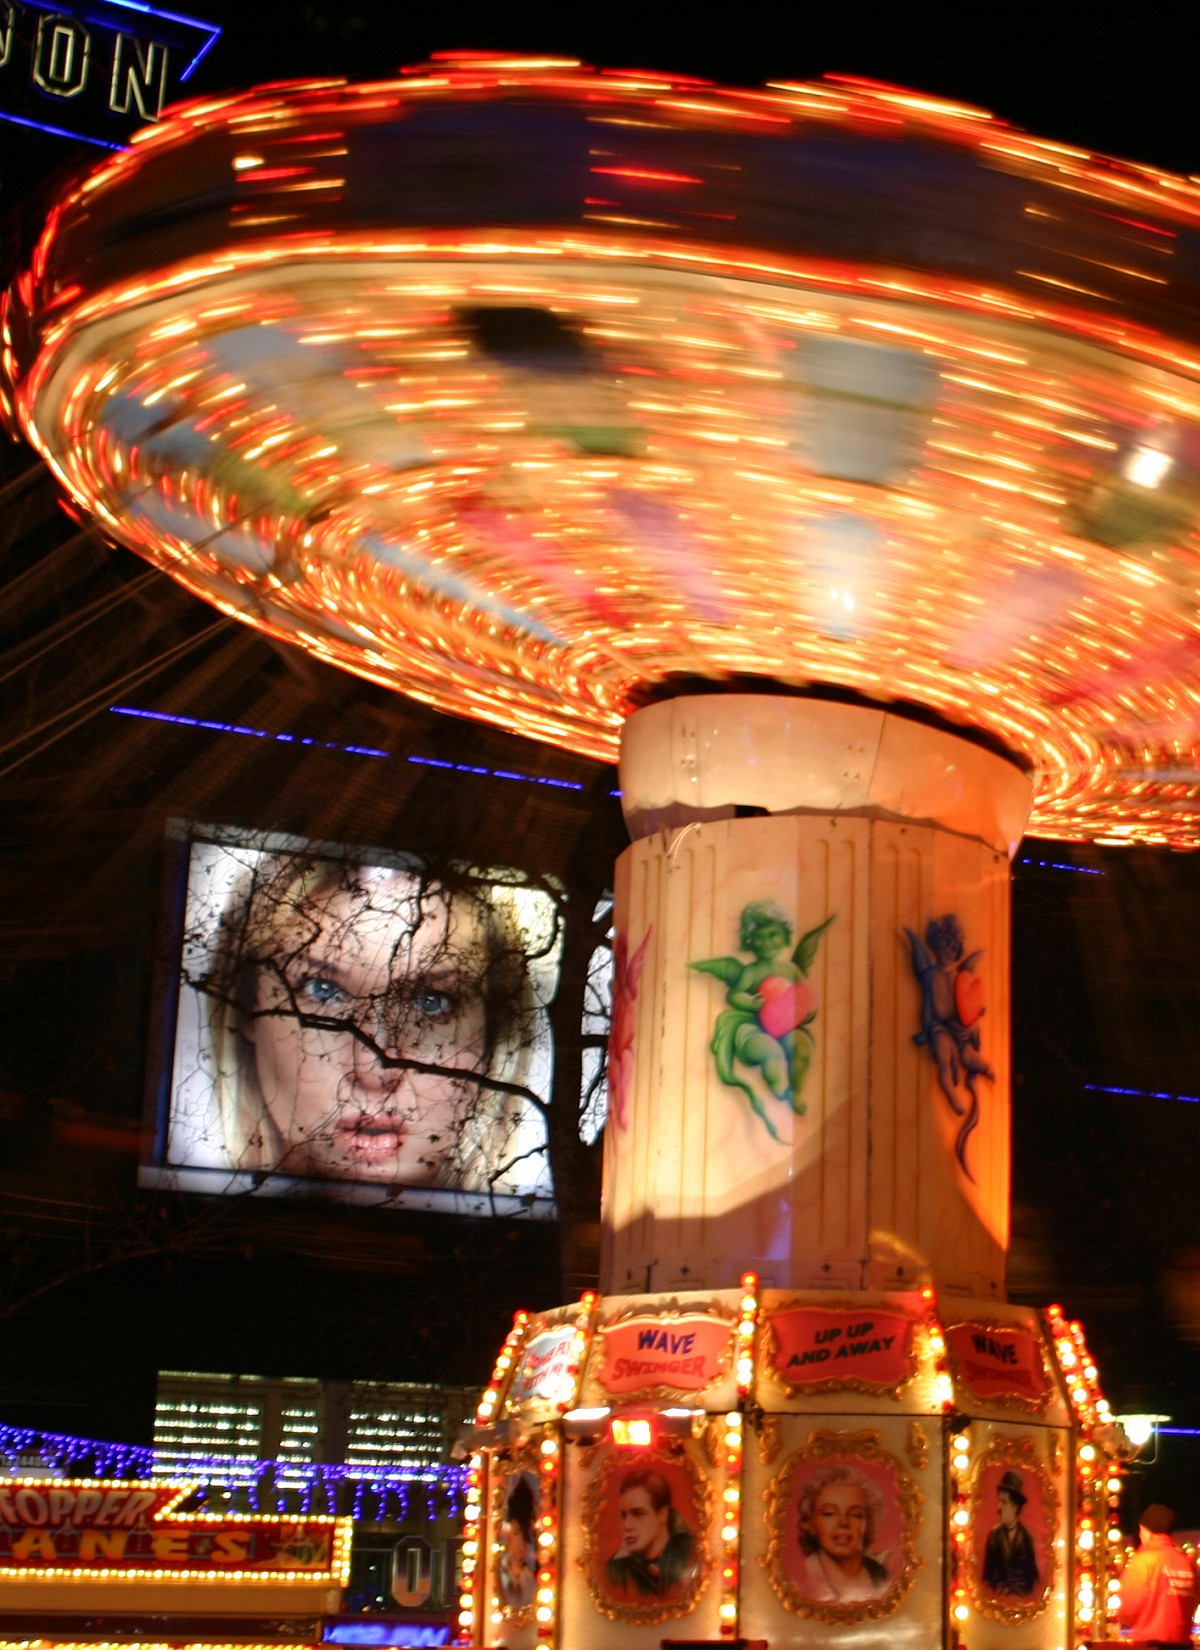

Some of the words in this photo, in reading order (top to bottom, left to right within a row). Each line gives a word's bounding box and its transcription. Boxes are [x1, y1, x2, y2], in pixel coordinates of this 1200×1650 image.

[0, 3, 168, 123] ON
[637, 1329, 697, 1355] WAVE
[814, 1328, 842, 1344] UP
[847, 1322, 874, 1339] UP
[787, 1348, 831, 1368] AND
[834, 1335, 896, 1359] AWAY
[611, 1355, 706, 1381] SWINGER
